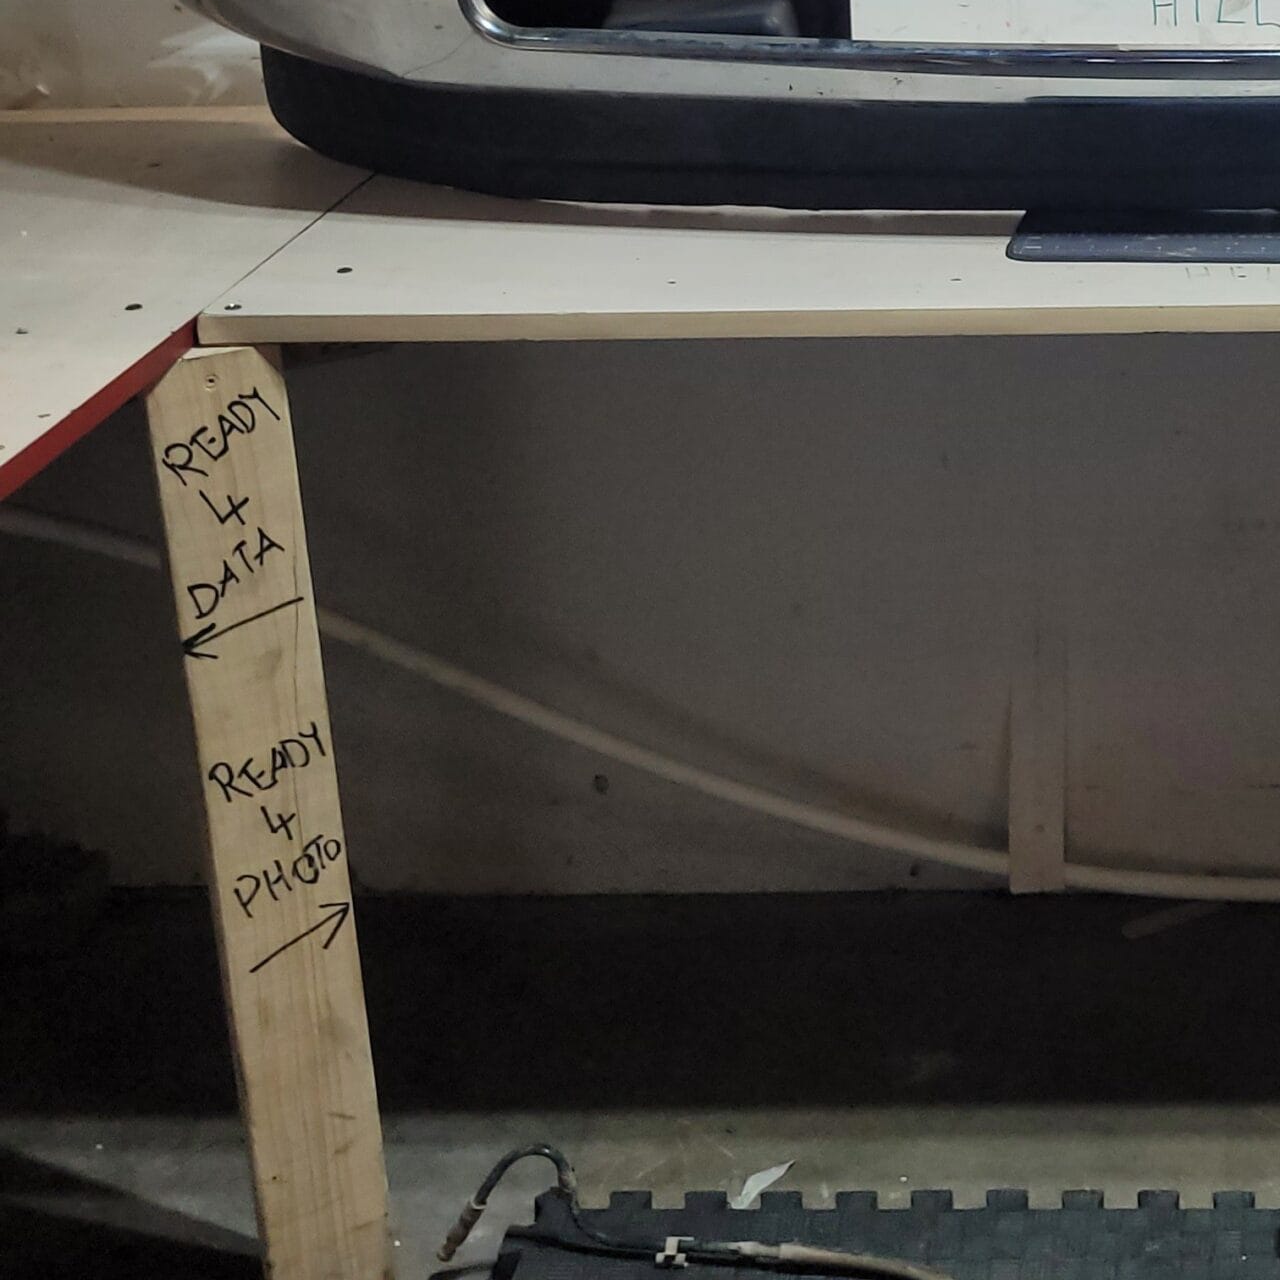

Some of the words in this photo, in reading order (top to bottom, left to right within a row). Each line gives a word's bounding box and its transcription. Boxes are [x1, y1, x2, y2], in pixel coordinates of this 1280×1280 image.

[162, 386, 281, 487] READY
[199, 489, 250, 526] 4
[187, 526, 286, 620] DATA
[208, 721, 327, 804] READY
[260, 805, 297, 841] 4
[233, 833, 342, 919] PHOTO
